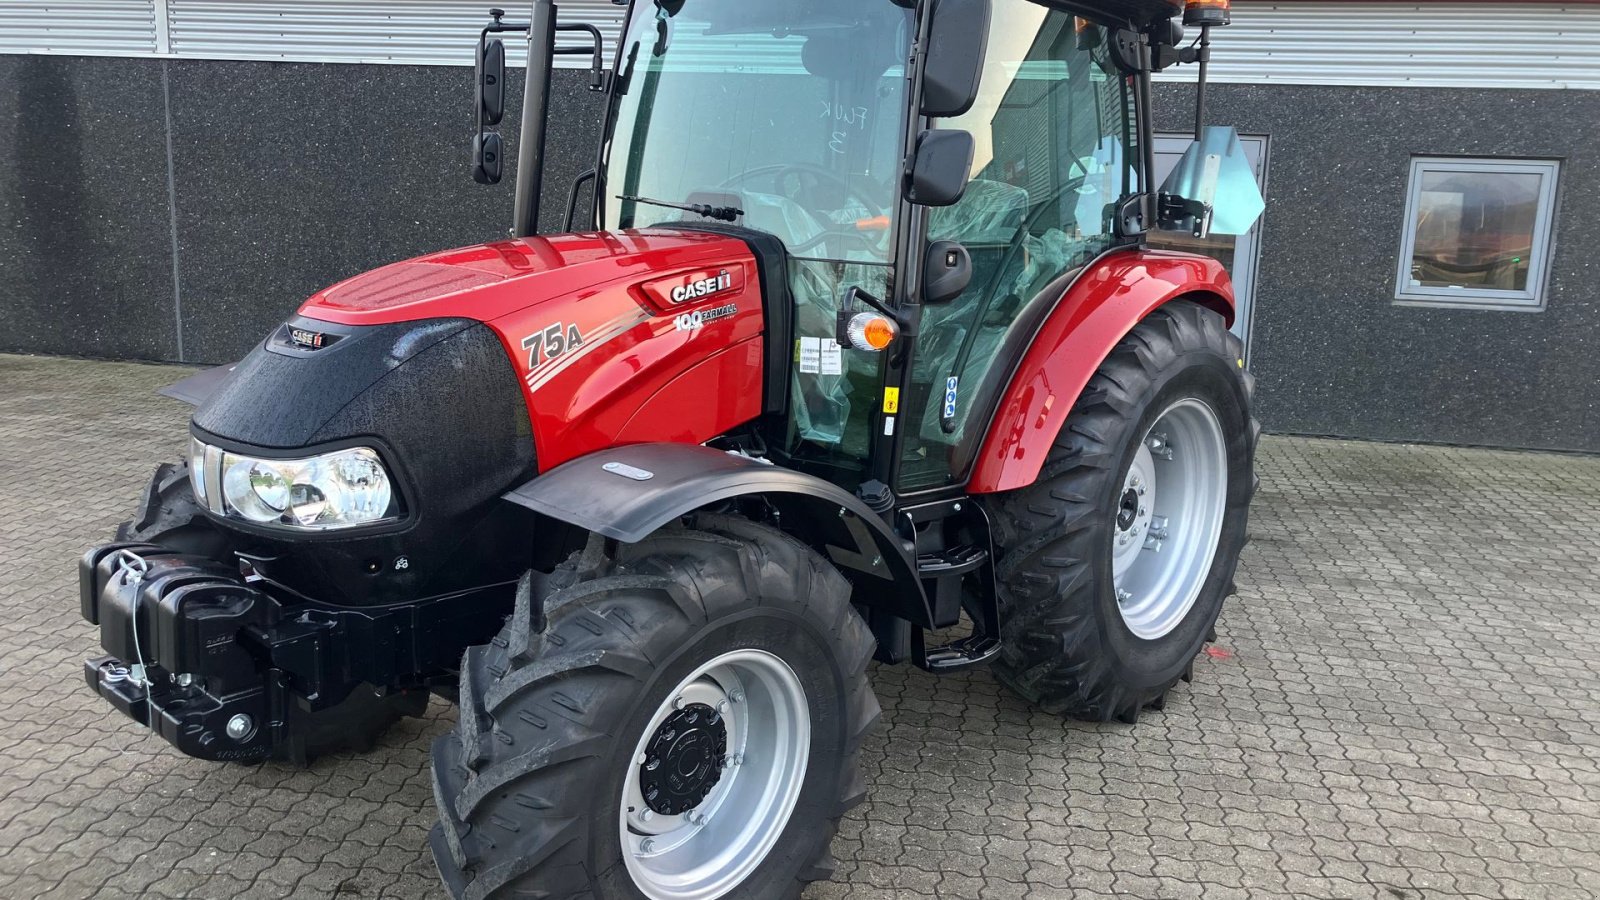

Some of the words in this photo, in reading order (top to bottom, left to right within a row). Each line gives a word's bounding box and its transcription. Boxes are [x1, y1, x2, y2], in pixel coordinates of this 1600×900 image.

[671, 277, 717, 303] CASE
[674, 310, 702, 331] 100
[701, 303, 738, 322] FARMALL
[292, 329, 313, 346] CASE
[521, 321, 586, 371] 75A
